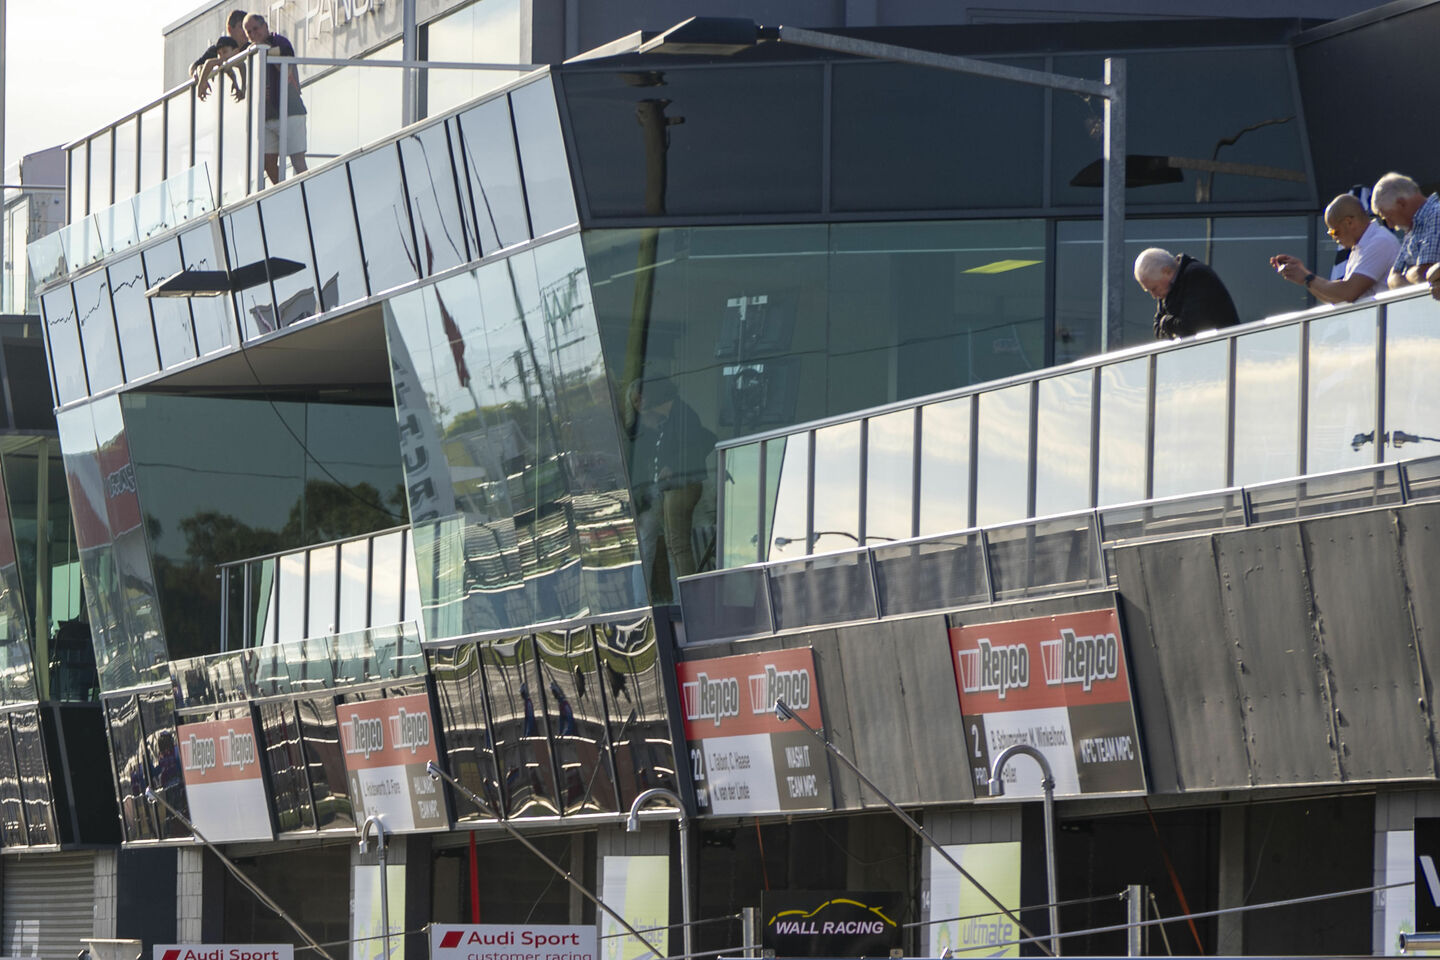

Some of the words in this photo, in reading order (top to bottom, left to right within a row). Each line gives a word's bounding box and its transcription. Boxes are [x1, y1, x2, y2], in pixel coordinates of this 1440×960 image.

[977, 639, 1029, 698] Repco
[1060, 629, 1118, 691] Repco
[698, 673, 739, 726] Repco
[351, 714, 383, 759] Repco
[398, 707, 429, 753] Repco
[972, 724, 982, 757] 2
[691, 748, 704, 781] 22
[1080, 739, 1097, 763] KFC
[1095, 737, 1118, 762] TEAM
[1116, 736, 1134, 760] MPC
[467, 931, 515, 946] Audi
[521, 931, 580, 948] Sport
[776, 921, 820, 935] WALL
[822, 921, 884, 935] RACING
[963, 916, 1013, 946] ultimate
[184, 949, 224, 960] Audi
